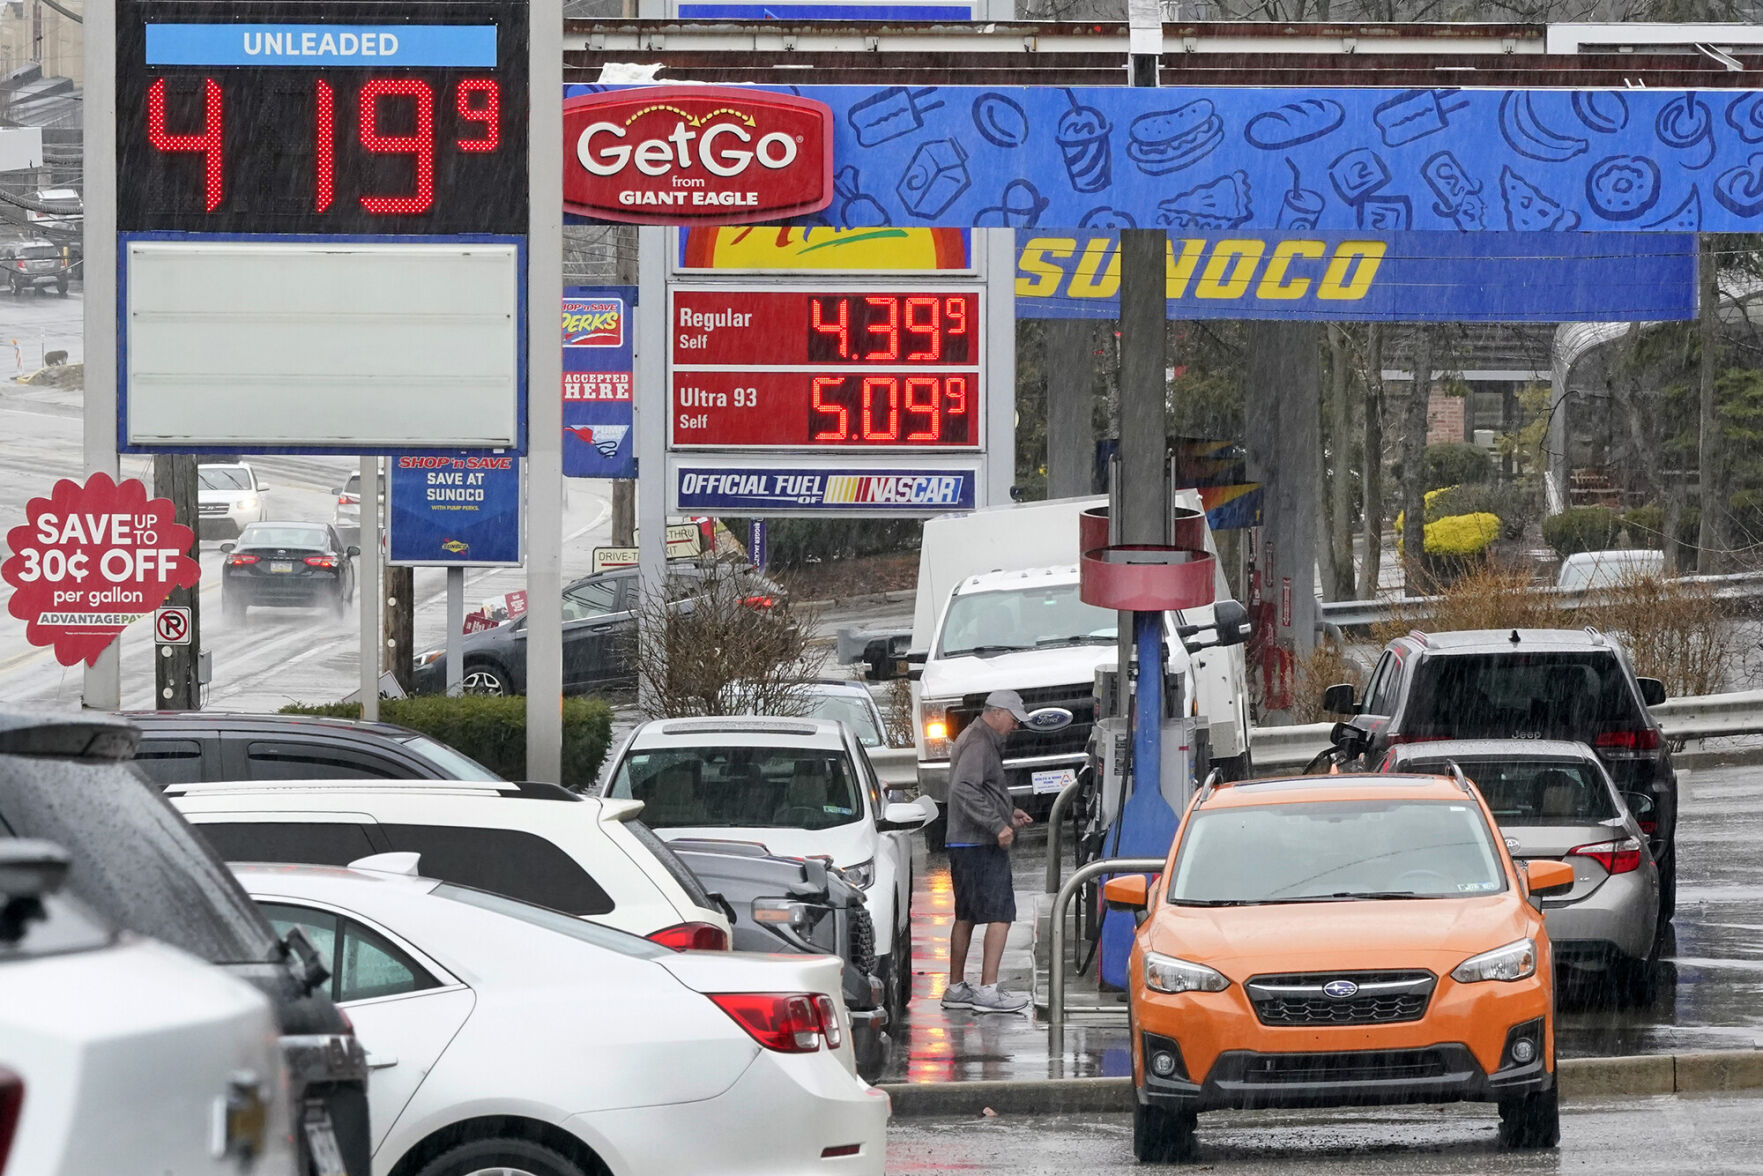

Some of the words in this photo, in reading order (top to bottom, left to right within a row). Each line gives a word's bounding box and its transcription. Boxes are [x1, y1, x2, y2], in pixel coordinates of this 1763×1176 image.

[243, 32, 399, 56] UNLEADED
[671, 175, 705, 188] from
[618, 190, 688, 206] GIANT
[692, 191, 759, 206] EAGLE
[1015, 237, 1388, 301] SUNOCO
[591, 303, 618, 312] SAVE
[679, 307, 752, 332] Regular
[679, 335, 708, 350] Self
[564, 374, 629, 383] ACCEPTED
[564, 383, 629, 399] HERE
[679, 387, 728, 407] Ultra
[733, 388, 758, 407] 93
[679, 414, 708, 429] Self
[398, 456, 450, 470] SHOP
[465, 456, 512, 470] SAVE
[427, 472, 463, 485] SAVE
[466, 472, 485, 485] AT
[681, 473, 769, 495] OFFICIAL
[773, 475, 824, 495] FUEL
[426, 488, 485, 501] SUNOCO
[865, 476, 957, 505] NASCAR
[797, 496, 824, 505] OF
[36, 512, 132, 545] SAVE
[134, 514, 158, 529] UP
[133, 530, 158, 546] TO
[17, 547, 90, 584] 30¢
[100, 548, 180, 583] OFF
[53, 590, 84, 607] per
[88, 586, 143, 607] gallon
[1036, 713, 1061, 725] Ford
[1511, 730, 1542, 740] Jeep
